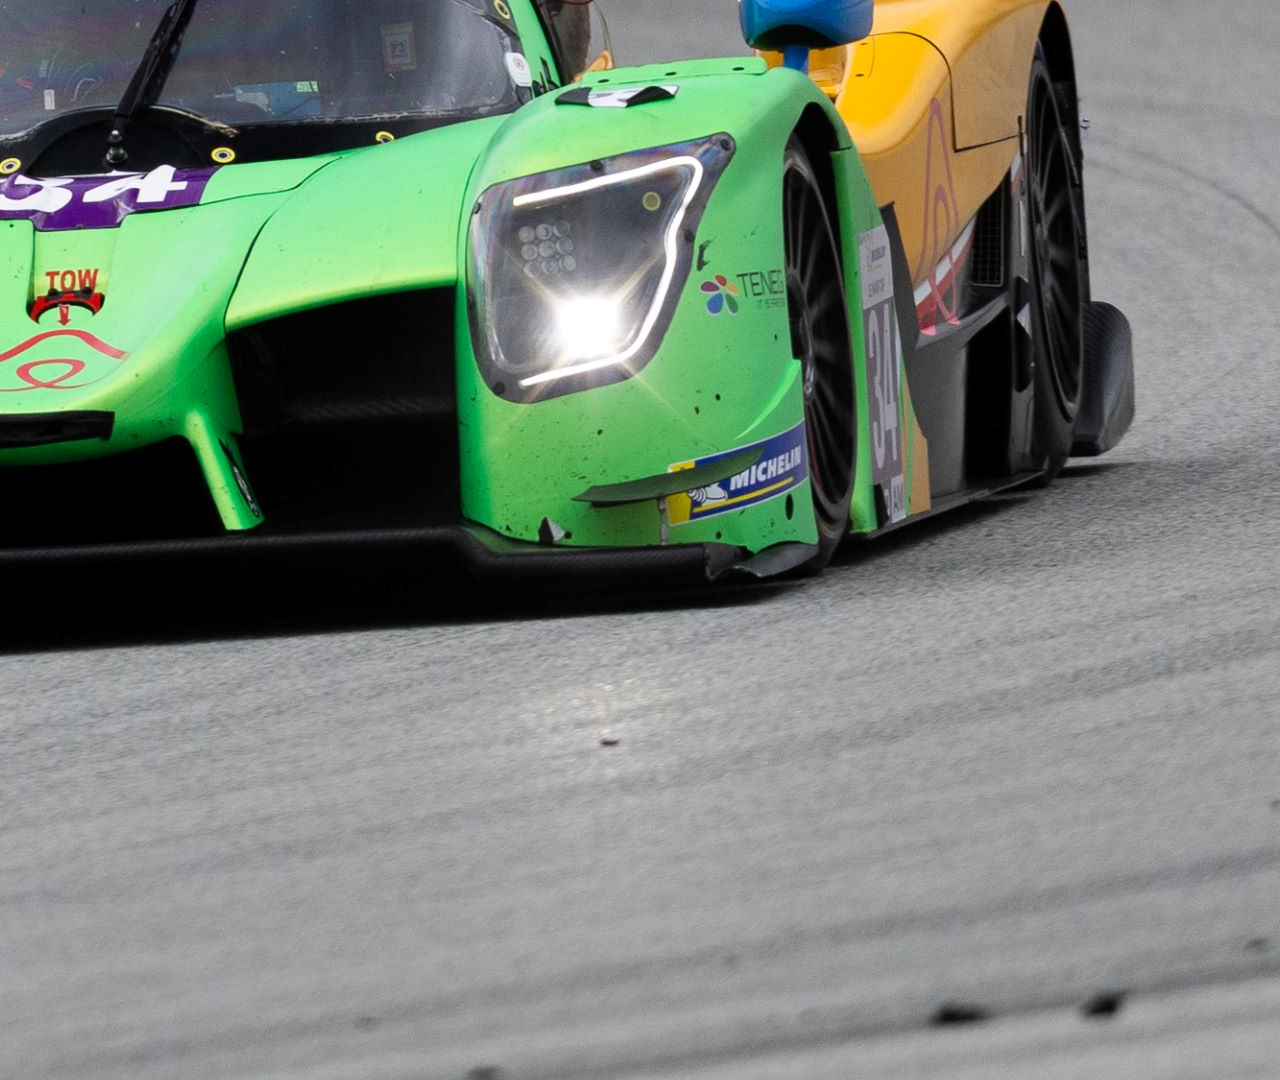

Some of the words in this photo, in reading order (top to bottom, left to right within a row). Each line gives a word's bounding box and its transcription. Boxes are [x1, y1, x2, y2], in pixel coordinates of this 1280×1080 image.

[45, 268, 99, 294] TOW
[868, 303, 898, 469] 34
[729, 444, 802, 491] MICHELIN
